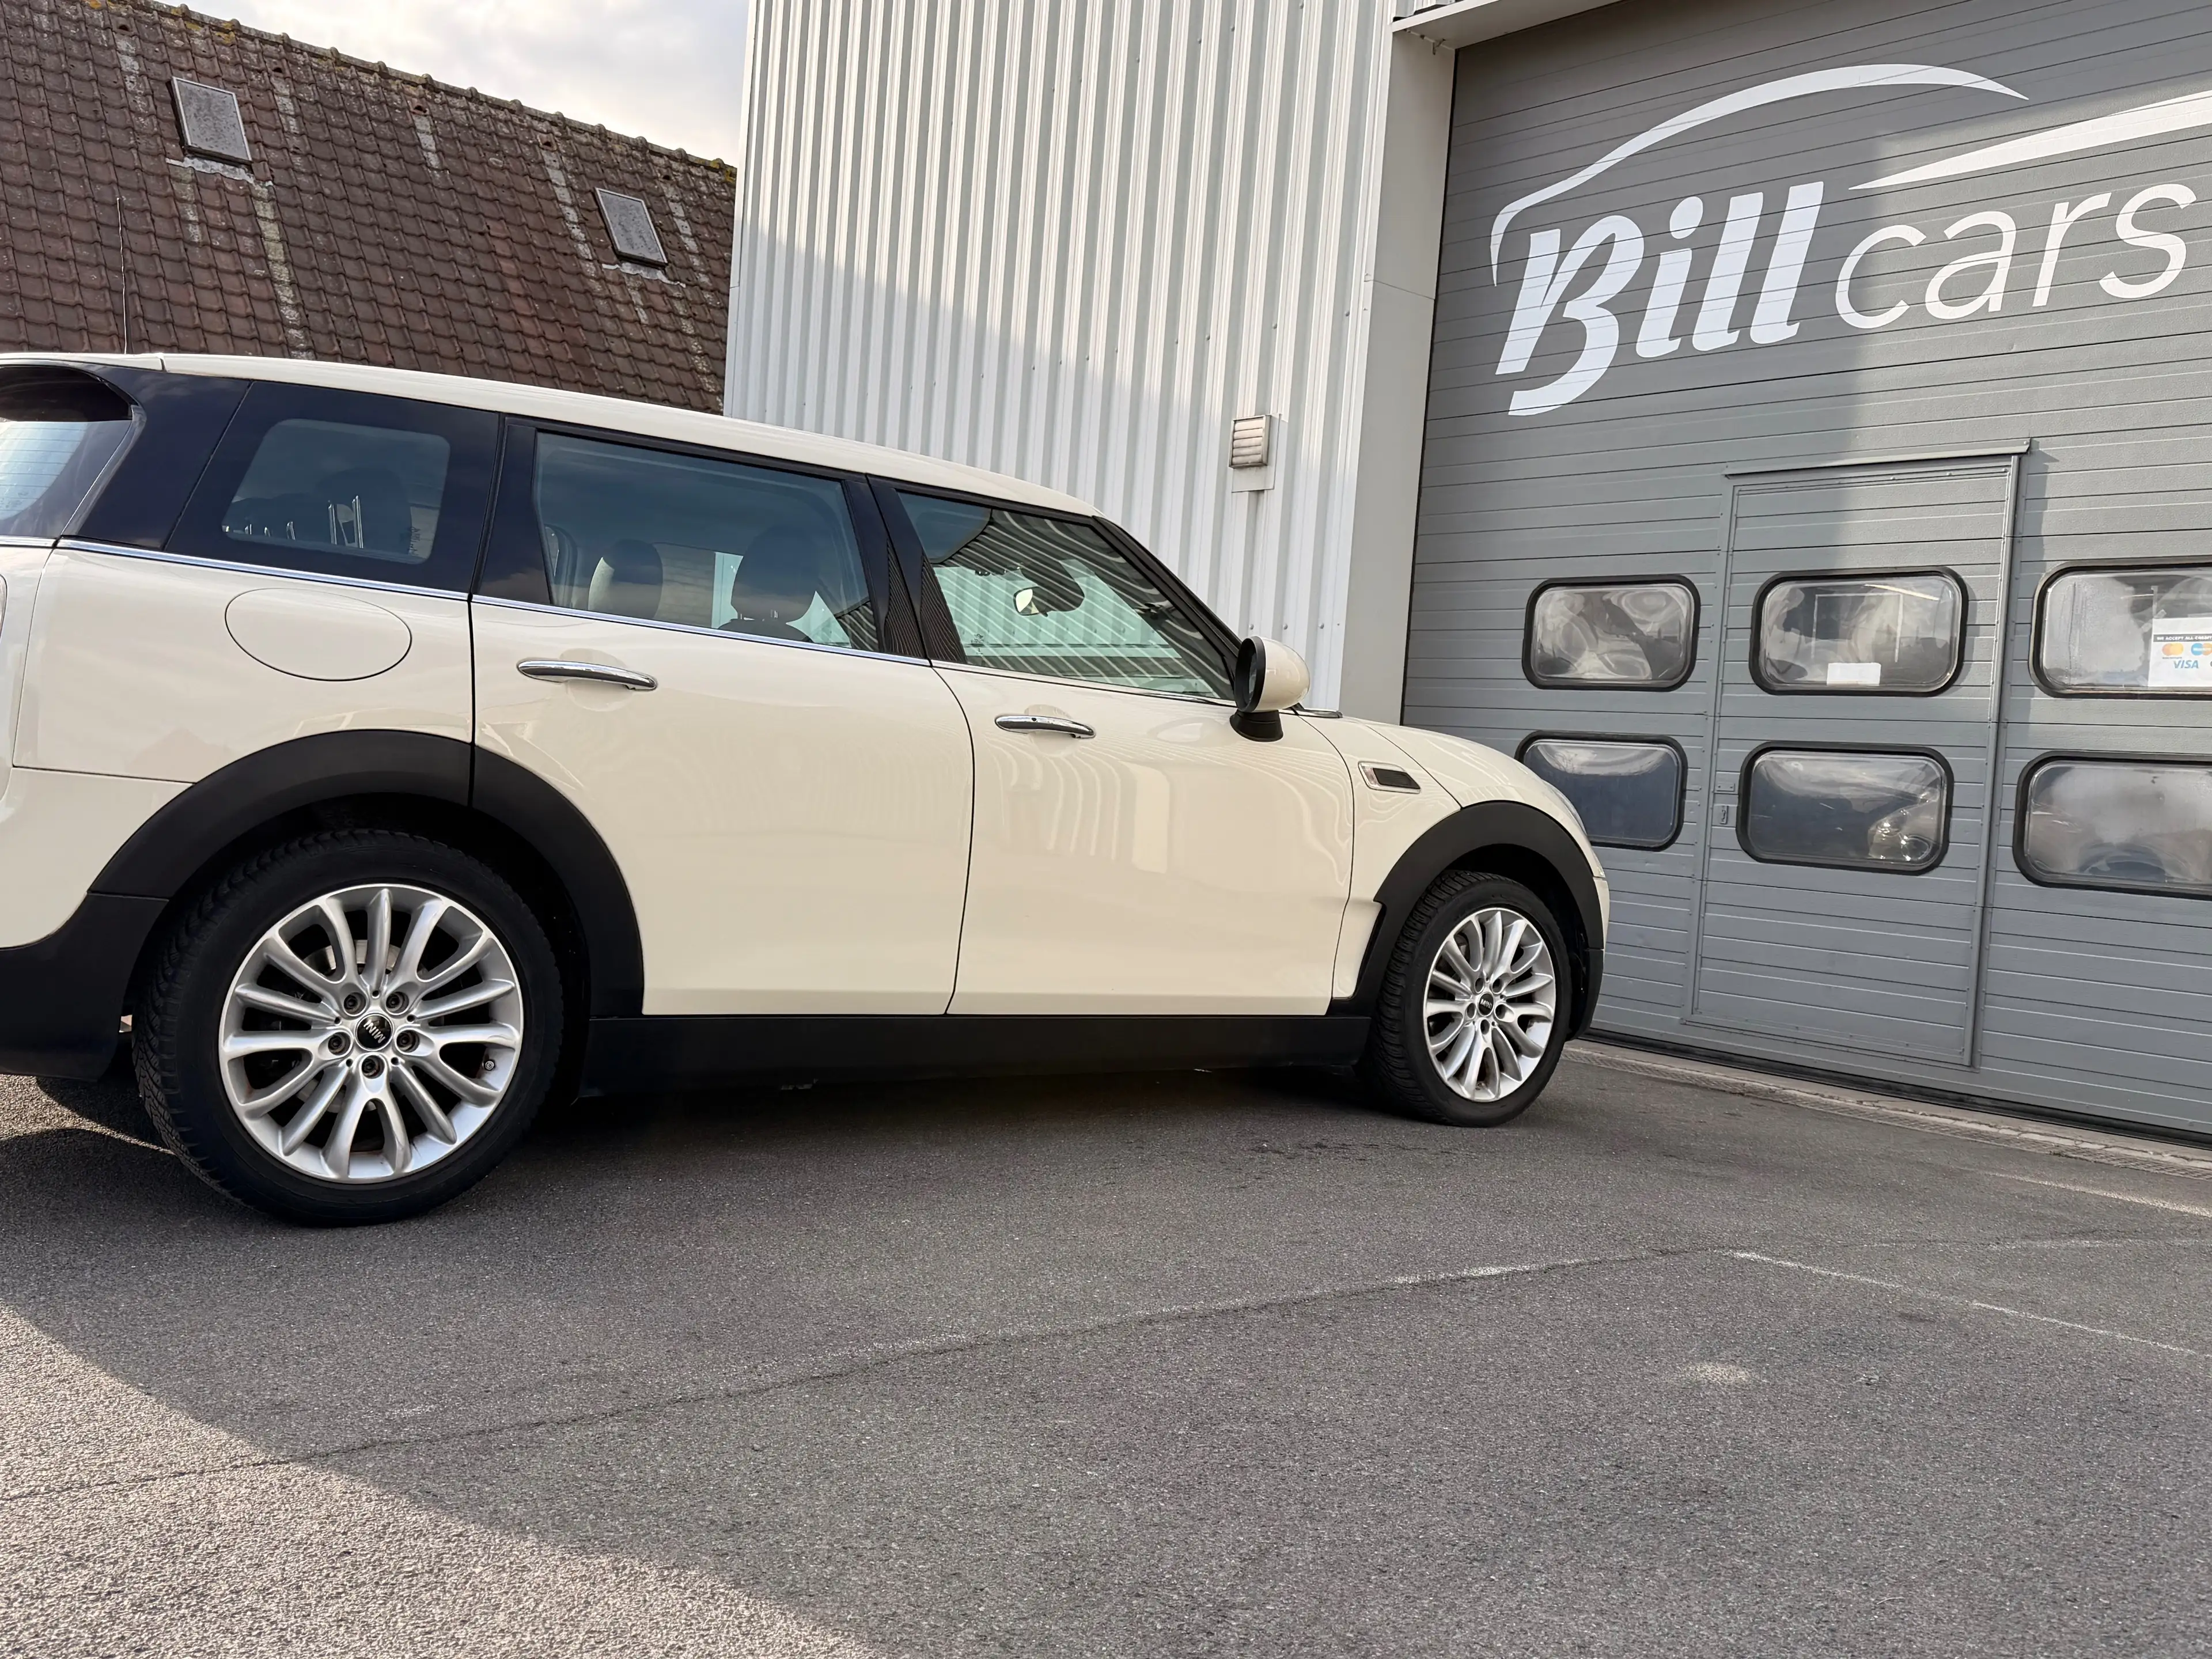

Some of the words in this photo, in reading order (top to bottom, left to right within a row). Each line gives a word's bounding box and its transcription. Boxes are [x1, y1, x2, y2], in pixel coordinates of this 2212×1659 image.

[1495, 181, 1824, 415] Bill
[1835, 183, 2197, 329] cars
[2173, 660, 2199, 669] VISA
[363, 1020, 385, 1043] MINI
